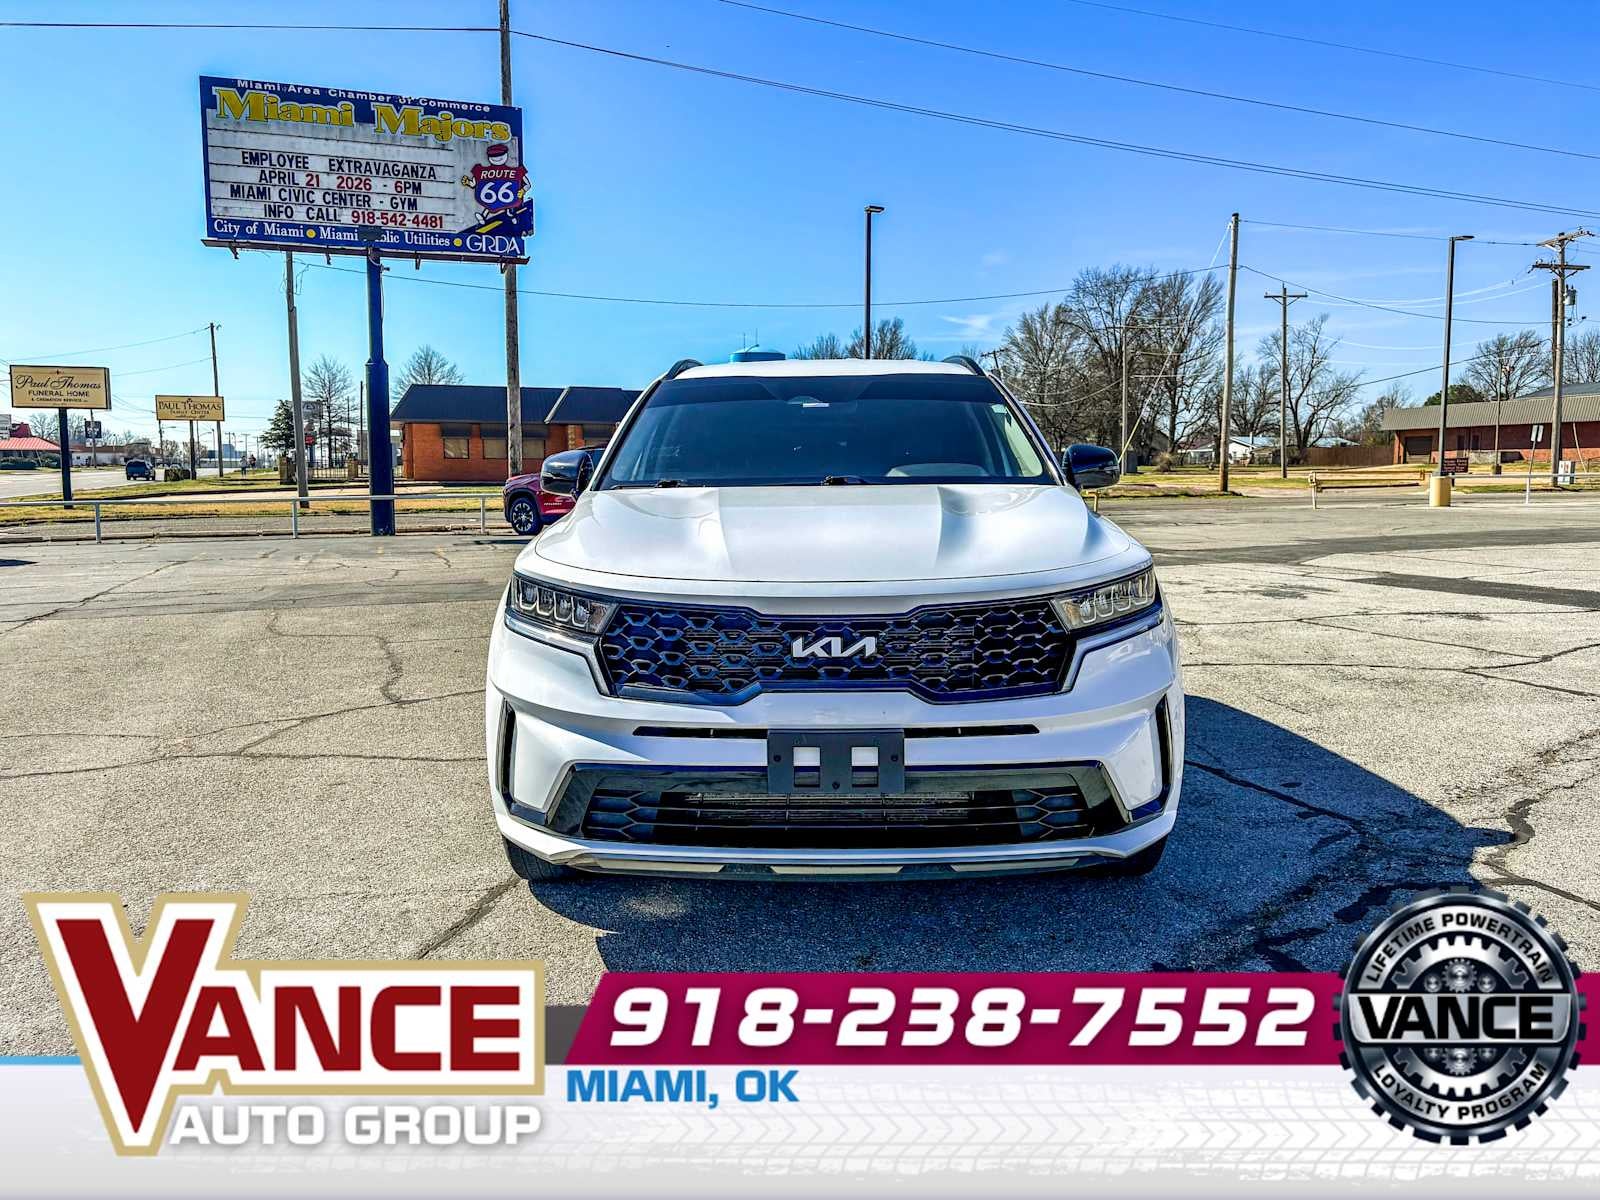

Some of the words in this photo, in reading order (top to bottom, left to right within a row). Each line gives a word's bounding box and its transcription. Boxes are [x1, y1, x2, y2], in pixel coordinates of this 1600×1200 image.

[237, 79, 280, 92] Miami
[287, 84, 321, 96] Area
[328, 88, 391, 102] Chamber
[398, 95, 415, 104] of
[419, 98, 490, 112] Commerce
[213, 87, 354, 128] Miami
[372, 103, 510, 142] Majors
[242, 150, 309, 170] EMPLOYEE
[328, 158, 437, 179] EXTRAVAGANZA
[480, 169, 516, 180] ROUTE
[259, 169, 299, 186] APRIL
[305, 173, 320, 188] 21
[336, 175, 372, 191] 2026
[394, 180, 422, 195] 6PM
[480, 181, 515, 204] 66
[230, 184, 271, 201] MIAMI
[278, 187, 315, 204] CIVIC
[322, 191, 372, 208] CENTER
[390, 196, 418, 211] GYM
[264, 204, 294, 219] INFO
[306, 207, 341, 222] CALL
[351, 210, 443, 228] 918-542-4481
[214, 219, 240, 237] City
[245, 222, 258, 235] of
[264, 222, 305, 238] Miami
[320, 226, 358, 241] Miami
[404, 231, 450, 246] Utilities
[466, 234, 520, 254] GRDA
[14, 374, 50, 389] Paul
[50, 375, 101, 390] Thomas
[158, 401, 181, 410] PAUL
[181, 401, 222, 410] THOMAS
[793, 636, 876, 657] KIA
